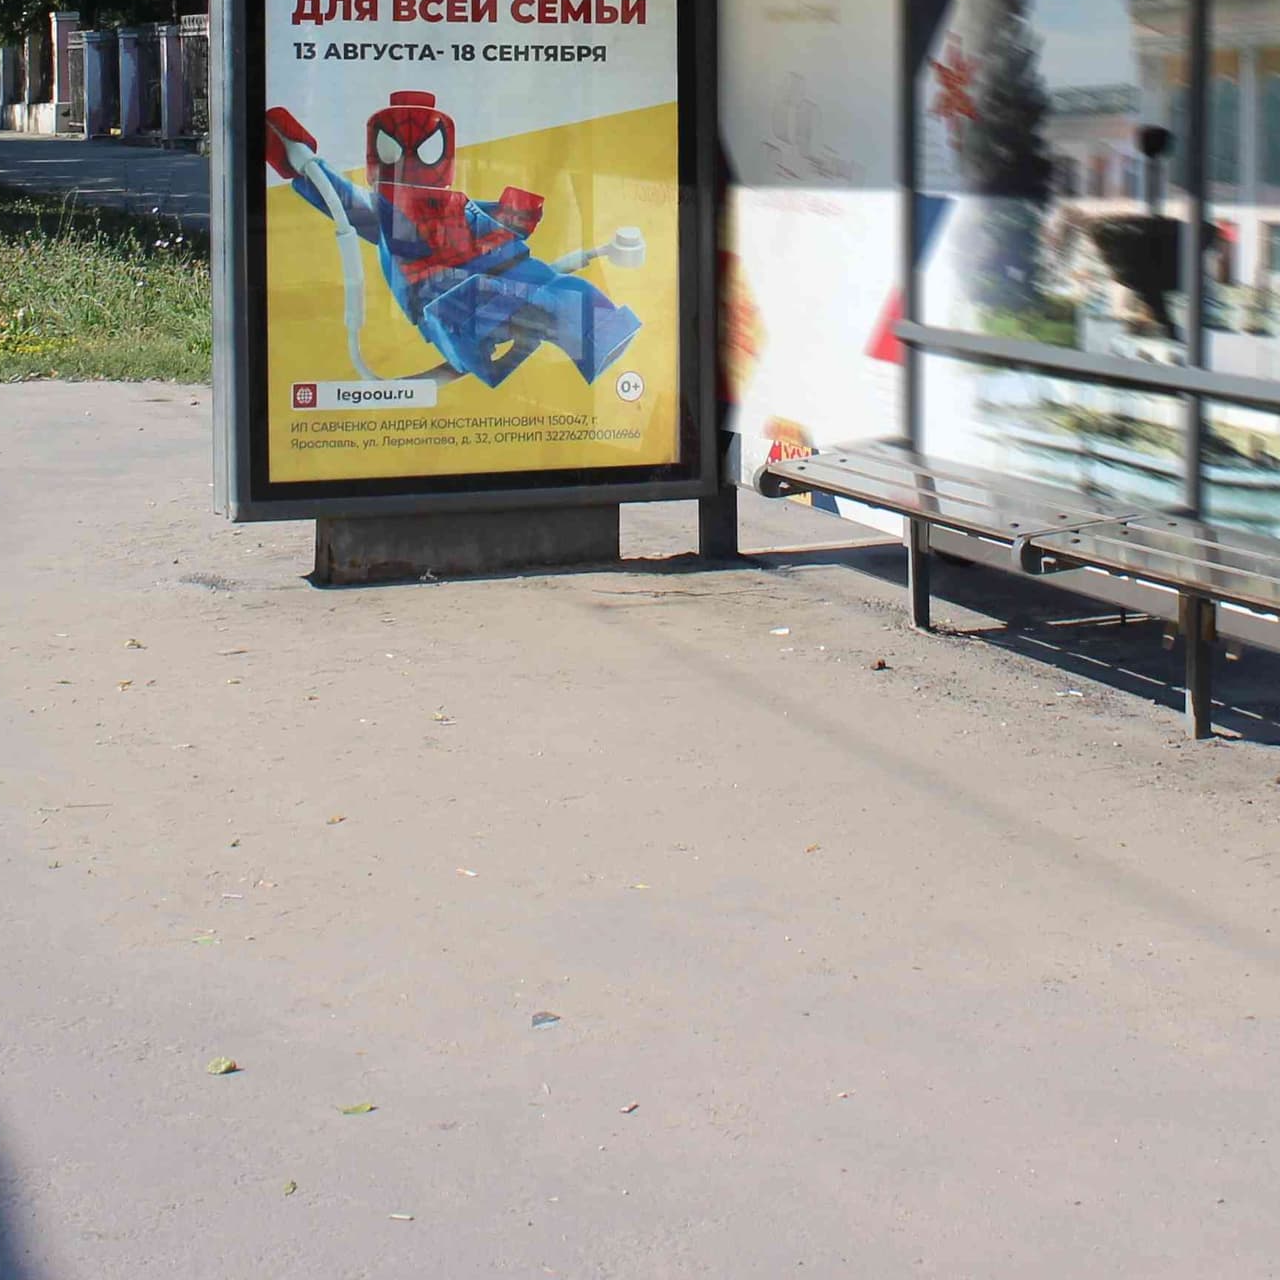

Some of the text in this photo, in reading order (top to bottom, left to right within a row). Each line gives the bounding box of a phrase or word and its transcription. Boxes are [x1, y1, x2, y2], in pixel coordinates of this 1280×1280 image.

[293, 42, 317, 61] 13
[451, 44, 476, 62] 18
[482, 45, 608, 63] СЕНТЯБРЯ
[621, 380, 641, 393] 0+
[337, 388, 415, 404] legoou.ru
[291, 421, 308, 433] ИП
[311, 420, 378, 433] САВЧЕНКО
[380, 417, 428, 431] АНДРЕЙ
[431, 415, 545, 429] КОНСТАНТИНОВИЧ
[291, 437, 360, 450] Ярославль,
[362, 437, 379, 450] ул.
[494, 430, 543, 444] ОГРНИП
